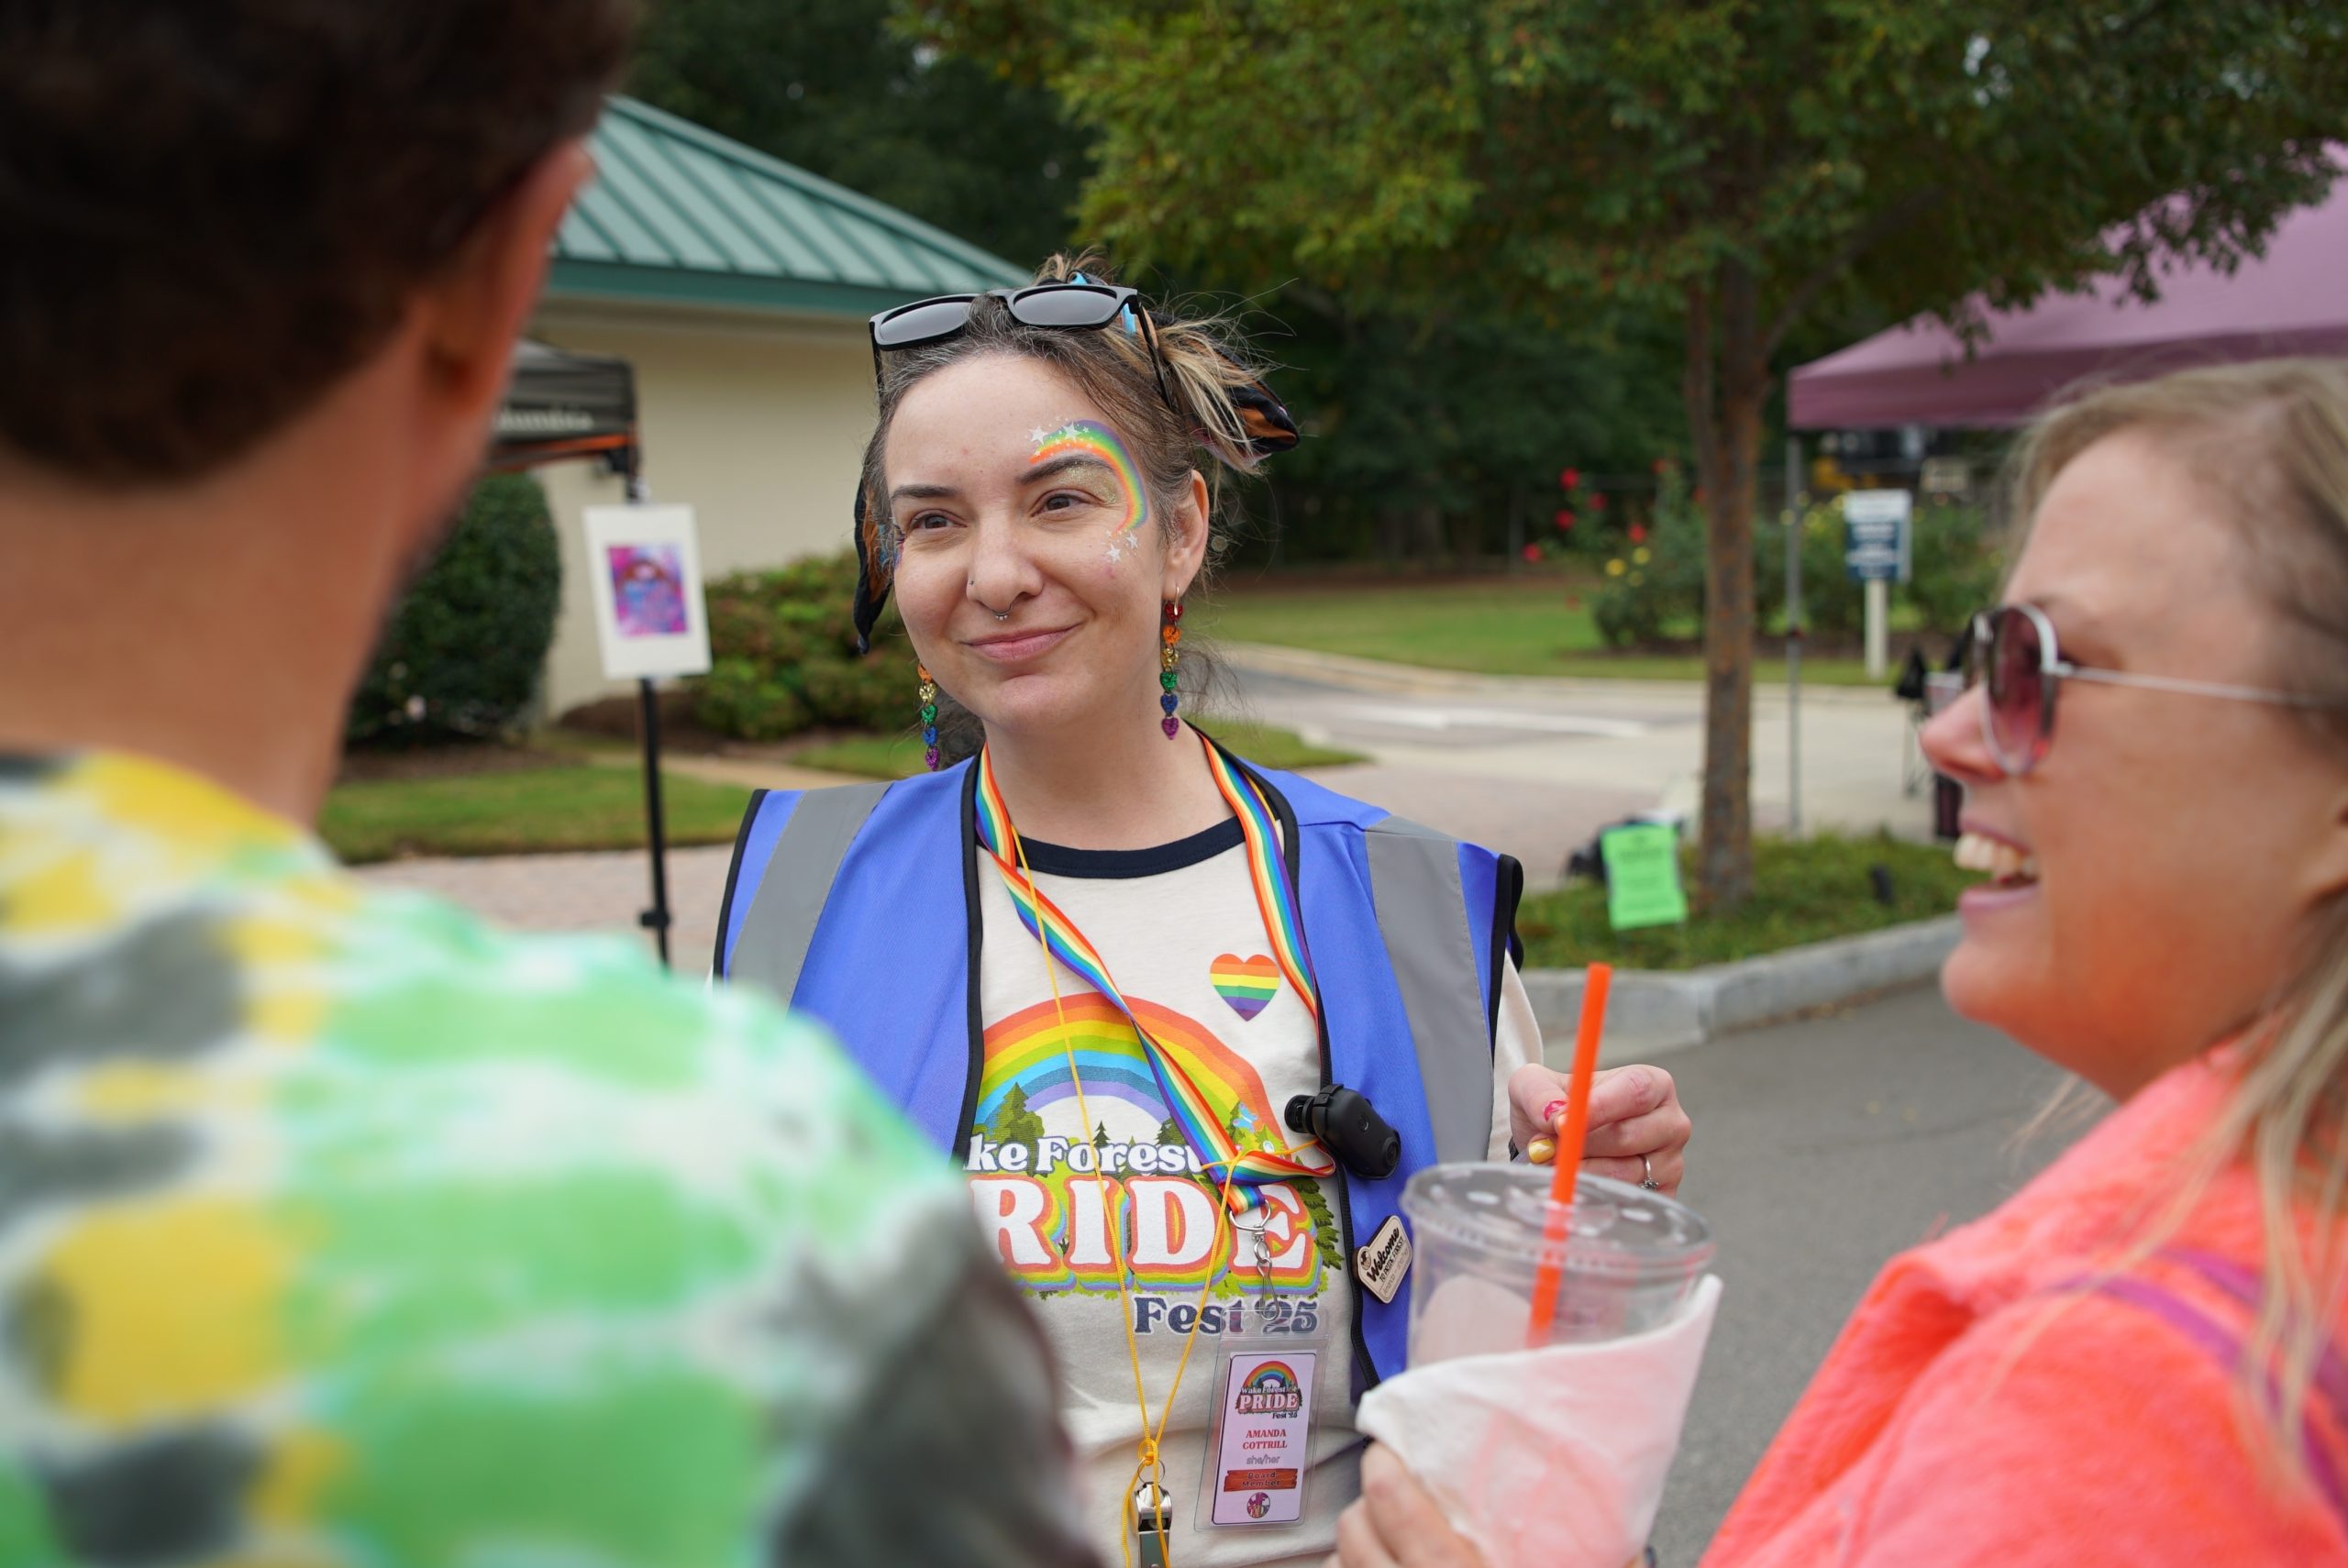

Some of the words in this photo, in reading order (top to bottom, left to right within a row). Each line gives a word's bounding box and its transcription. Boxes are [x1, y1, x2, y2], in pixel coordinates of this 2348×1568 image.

[963, 1132, 1029, 1172] ke
[967, 1176, 1309, 1274] RIDE
[1366, 1227, 1400, 1283] Welcome
[1134, 1296, 1246, 1335] Fest
[1239, 1393, 1299, 1410] PRIDE
[1246, 1429, 1287, 1439] AMANDA
[1242, 1440, 1288, 1450] COTTRILL
[1246, 1453, 1280, 1465] she/her
[1247, 1471, 1277, 1479] Board
